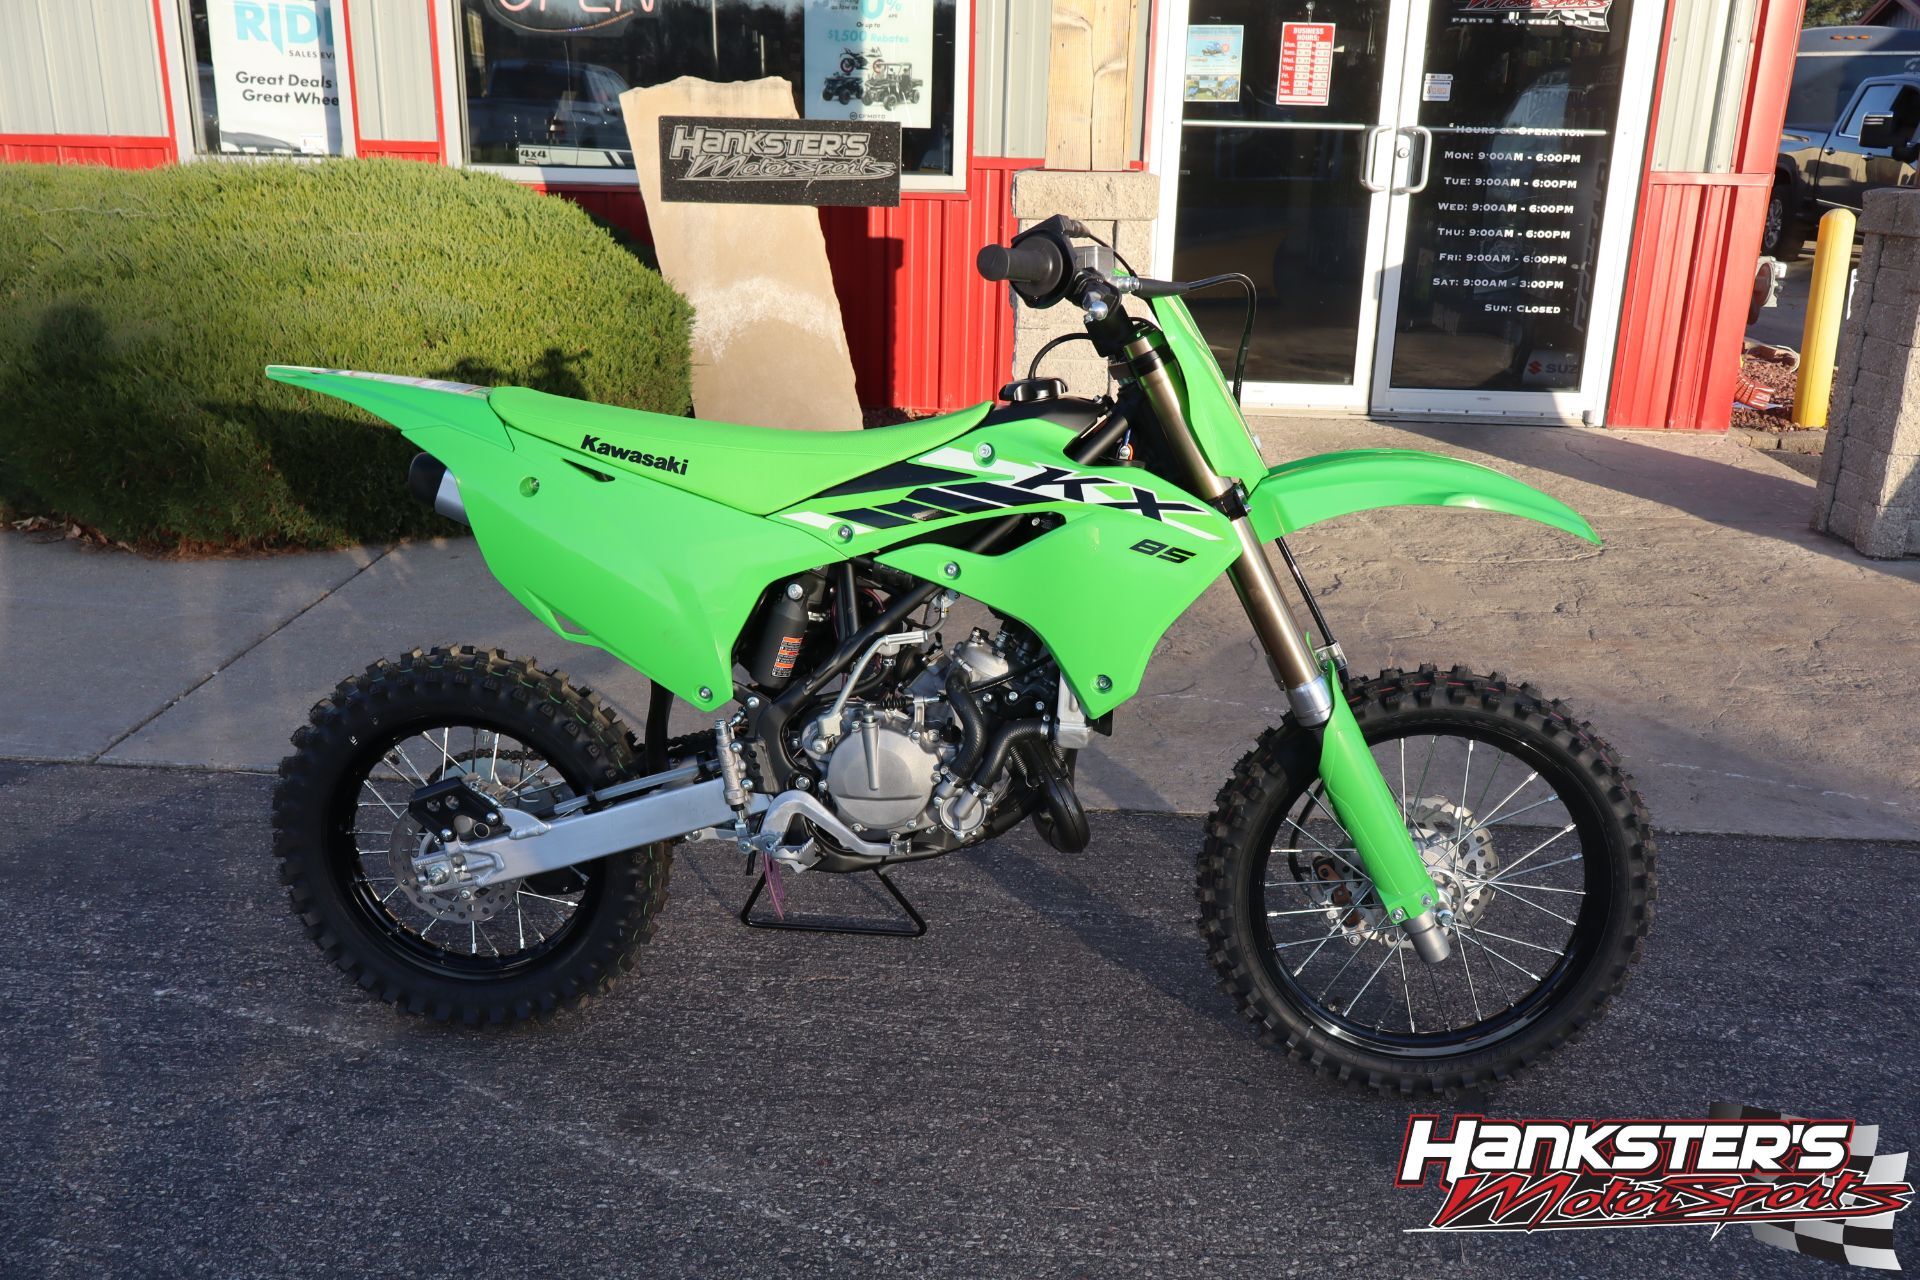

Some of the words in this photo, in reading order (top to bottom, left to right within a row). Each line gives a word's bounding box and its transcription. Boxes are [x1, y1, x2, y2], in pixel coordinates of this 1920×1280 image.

[289, 50, 318, 58] SALES
[236, 71, 284, 85] Great
[288, 74, 332, 88] Deals
[242, 89, 290, 103] Great
[520, 149, 547, 159] 4x4
[1444, 151, 1474, 160] MON:
[1478, 151, 1523, 162] 9:00AM
[1535, 153, 1581, 163] 6:00PM
[1444, 177, 1471, 186] TUE:
[1475, 177, 1520, 187] 9:00AM
[1532, 179, 1577, 189] 6:00PM
[1438, 202, 1467, 211] WED:
[1471, 203, 1517, 213] 9:00AM
[1529, 205, 1574, 214] 6:00PM
[1437, 227, 1465, 237] THU:
[1468, 228, 1514, 238] 9:00AM
[1526, 230, 1571, 239] 6:00PM
[1439, 253, 1462, 262] FRI:
[1466, 253, 1510, 263] 9:00AM
[1522, 255, 1567, 264] 6:00PM
[1432, 278, 1459, 286] SAT:
[1463, 278, 1507, 288] 9:00AM
[1519, 280, 1564, 290] 3:00PM
[1484, 303, 1512, 312] SUN:
[1516, 304, 1561, 314] CLOSED
[580, 434, 689, 476] Kawasaki
[1128, 538, 1198, 564] 85
